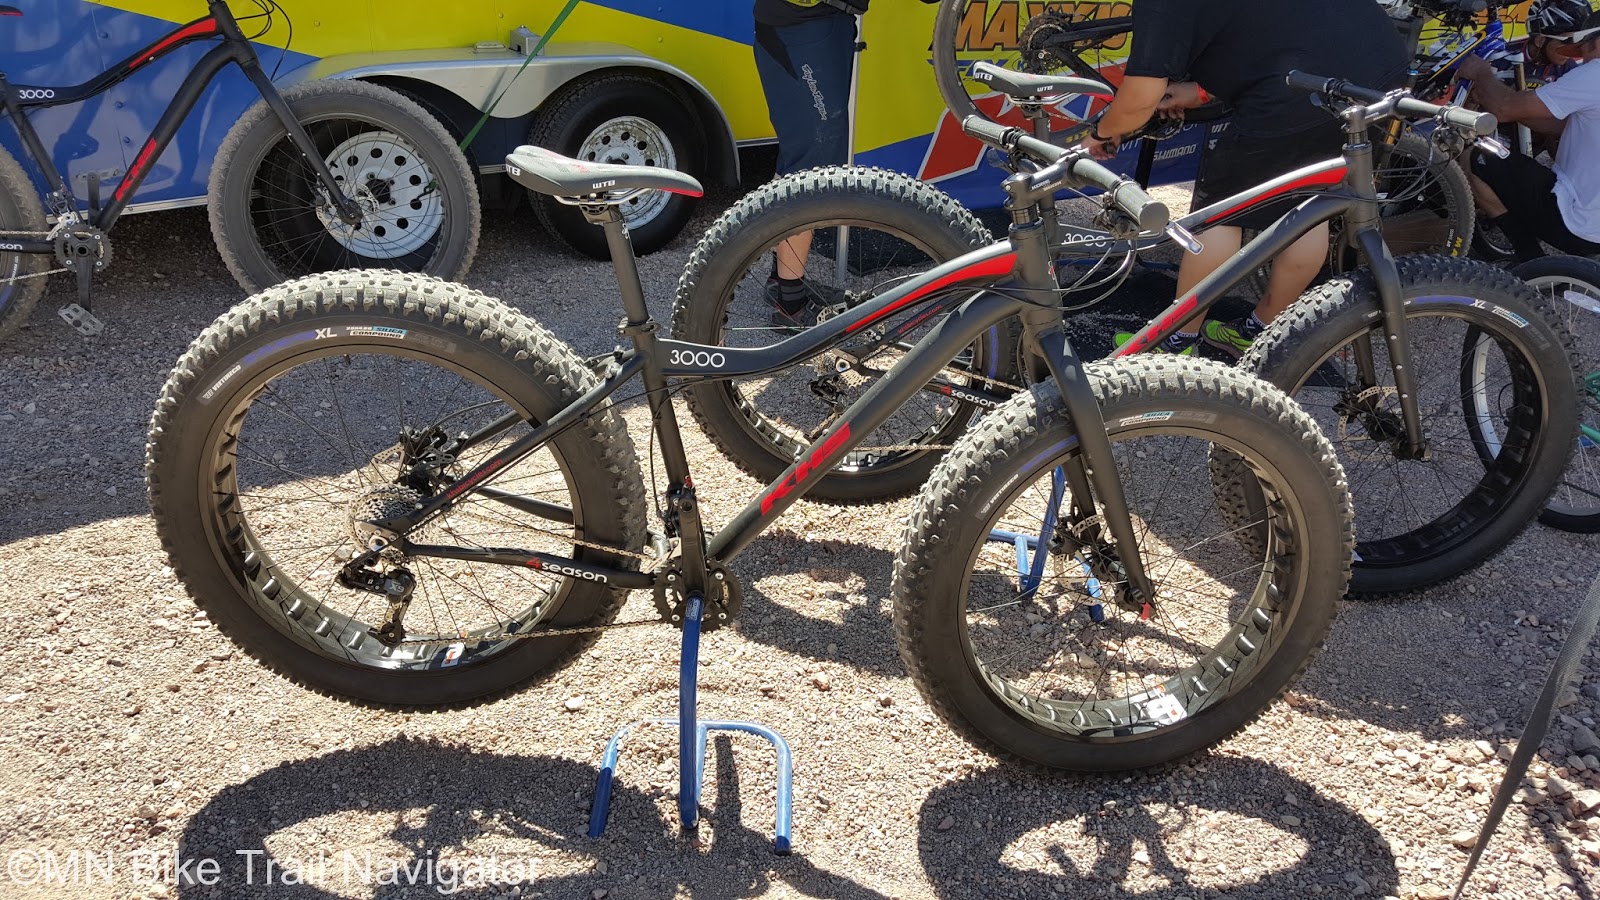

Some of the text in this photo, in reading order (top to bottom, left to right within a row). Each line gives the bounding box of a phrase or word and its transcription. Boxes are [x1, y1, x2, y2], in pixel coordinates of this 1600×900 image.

[19, 89, 55, 99] 3000
[1153, 144, 1197, 160] SHIMANO
[592, 180, 616, 189] WTB
[315, 327, 338, 340] XL
[351, 330, 403, 339] COMPOUND
[670, 349, 726, 368] 3000
[760, 421, 851, 516] KHS
